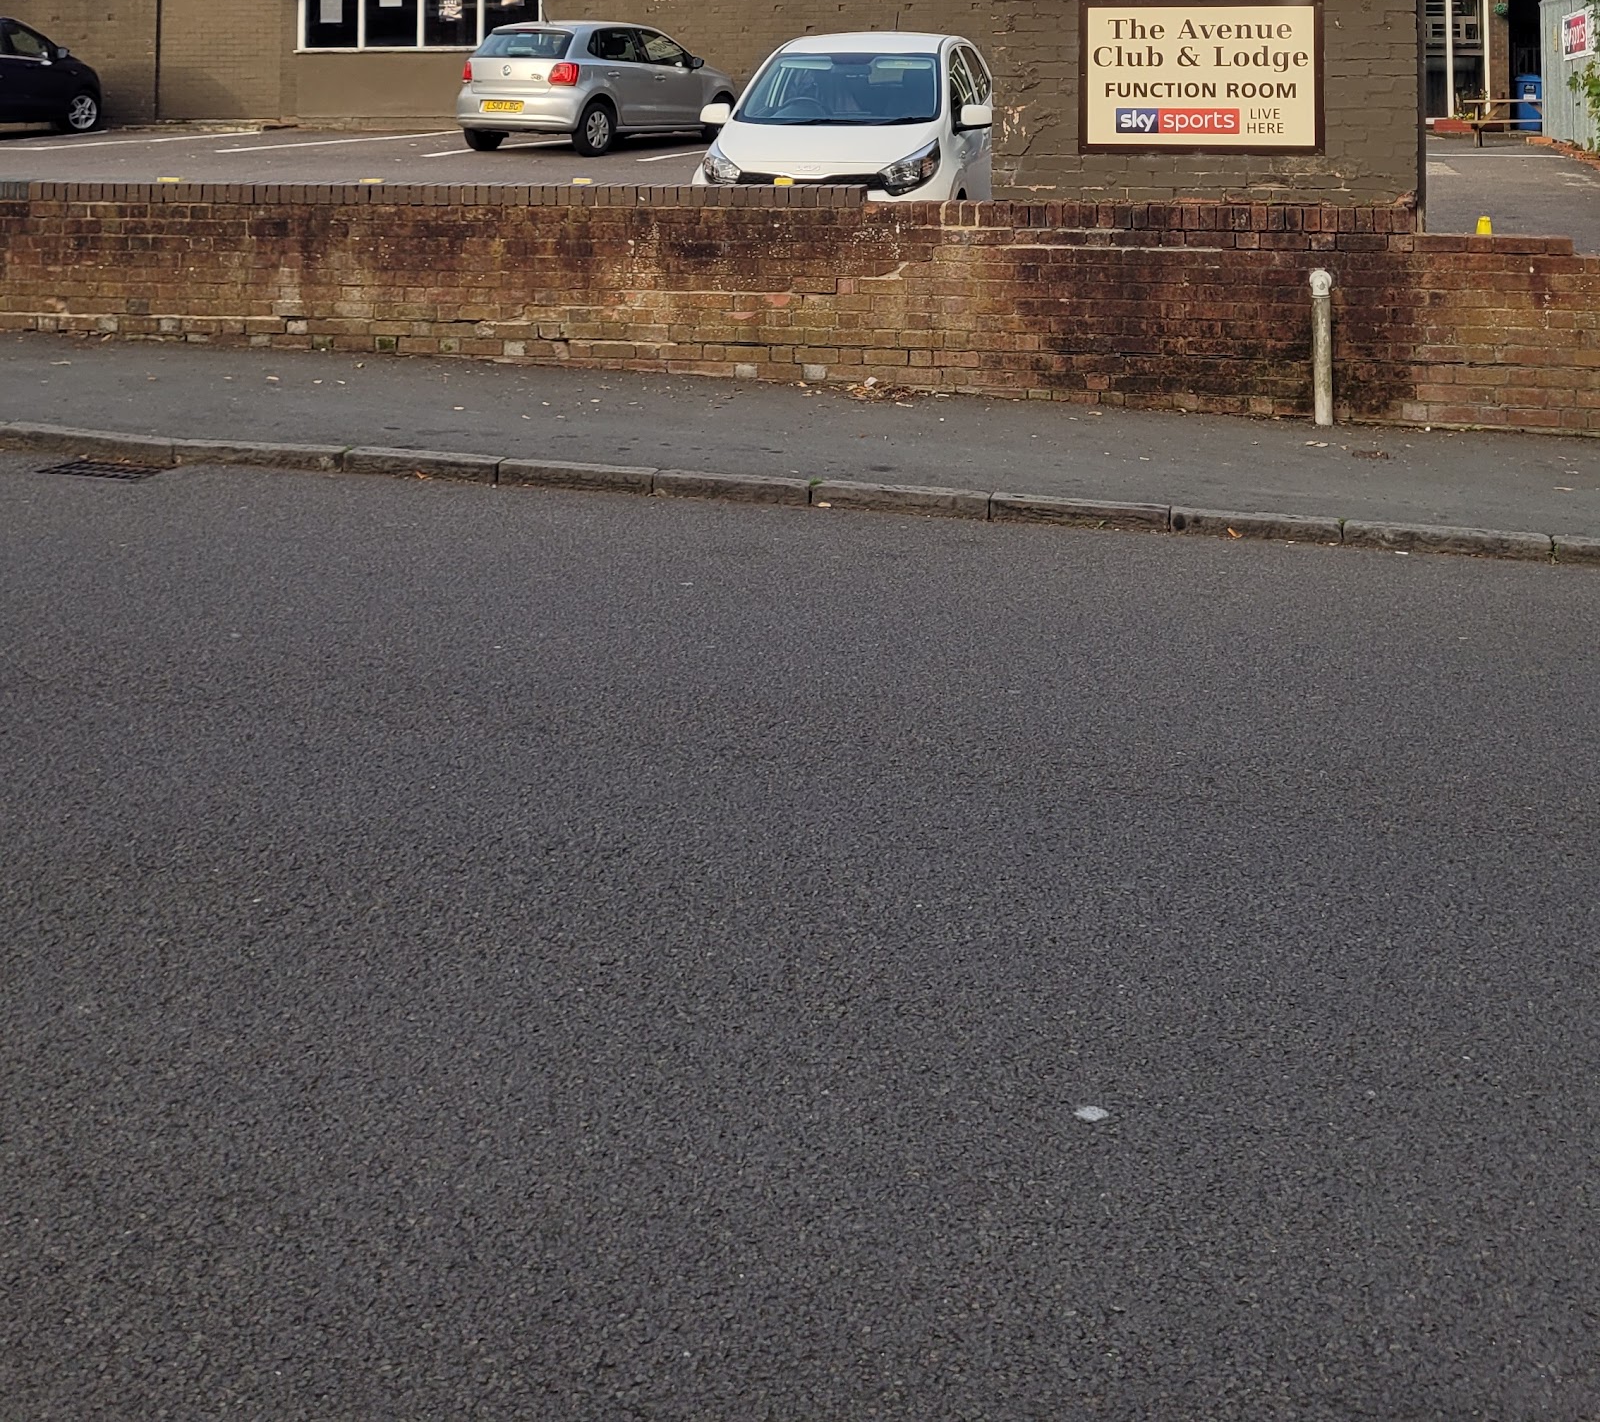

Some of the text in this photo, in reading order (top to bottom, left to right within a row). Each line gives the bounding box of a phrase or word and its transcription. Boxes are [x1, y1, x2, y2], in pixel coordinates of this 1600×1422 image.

[1107, 18, 1292, 40] The Avenue
[1093, 45, 1309, 73] Club & Lodge
[1105, 82, 1297, 99] FUNCTION ROOM
[1120, 109, 1235, 132] sky sports
[1250, 108, 1281, 120] LIVE
[1247, 122, 1284, 134] HERE
